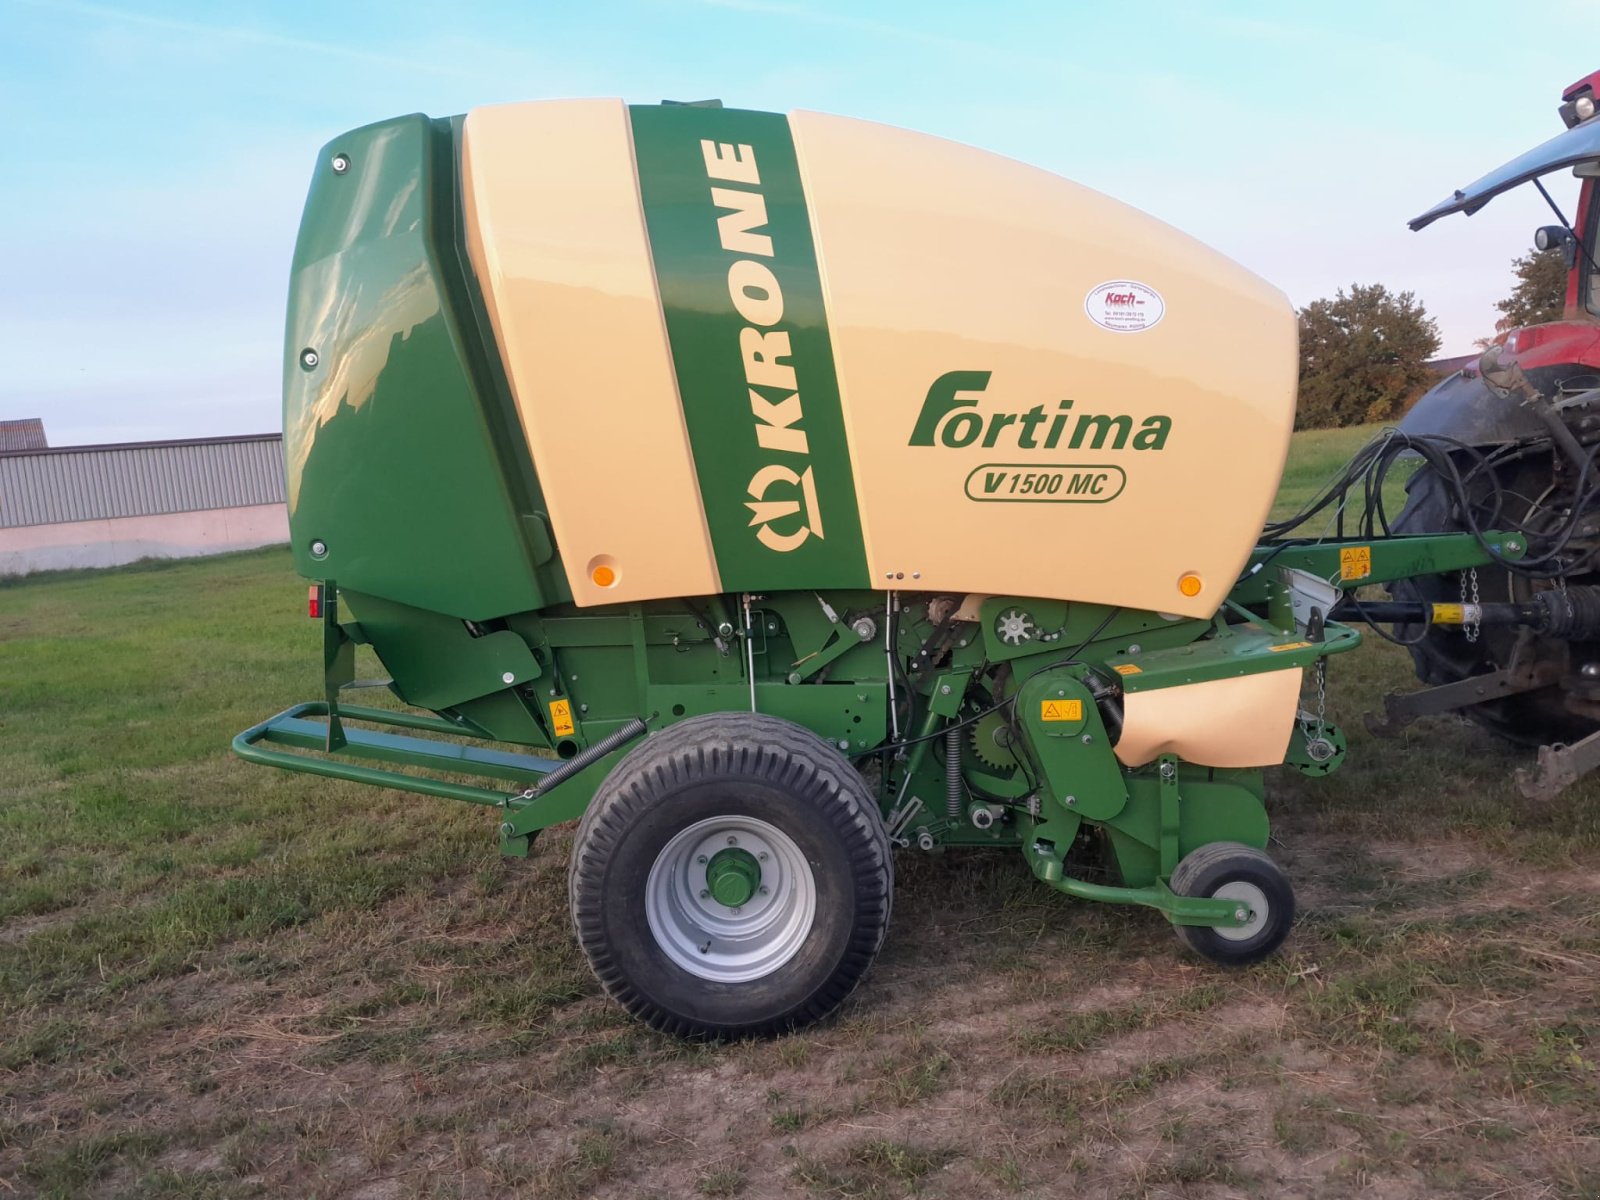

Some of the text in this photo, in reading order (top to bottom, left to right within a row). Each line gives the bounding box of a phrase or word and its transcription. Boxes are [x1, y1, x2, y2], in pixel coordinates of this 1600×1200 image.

[700, 139, 809, 454] KRONE
[907, 370, 1173, 451] Fortima
[984, 472, 1108, 495] V 1500 MC
